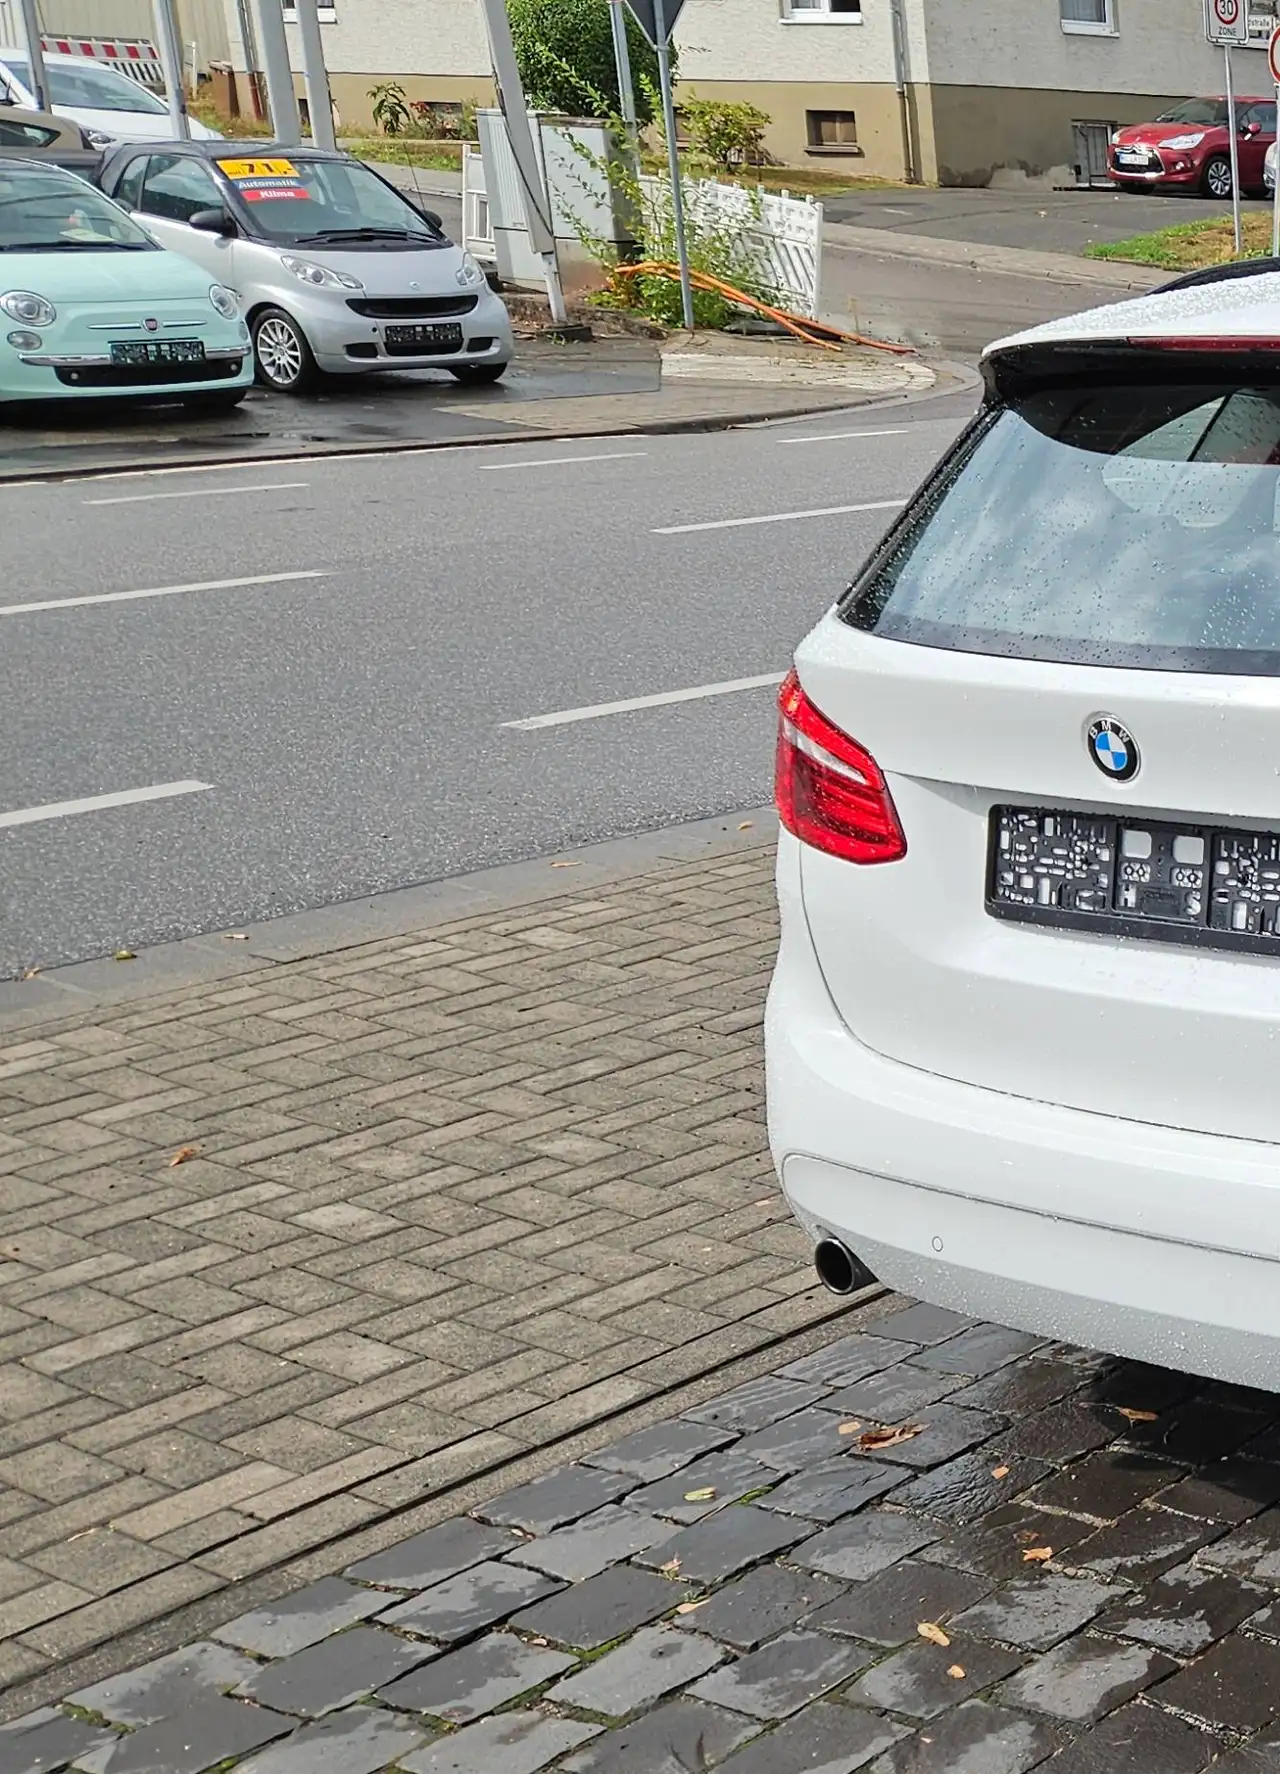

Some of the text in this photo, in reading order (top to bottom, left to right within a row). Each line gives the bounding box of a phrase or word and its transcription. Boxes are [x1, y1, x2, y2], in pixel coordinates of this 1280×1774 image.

[1220, 0, 1234, 15] 30
[1218, 26, 1237, 36] ZONE
[239, 180, 297, 189] Automatik
[260, 189, 296, 198] Klima
[1089, 720, 1131, 743] BMW
